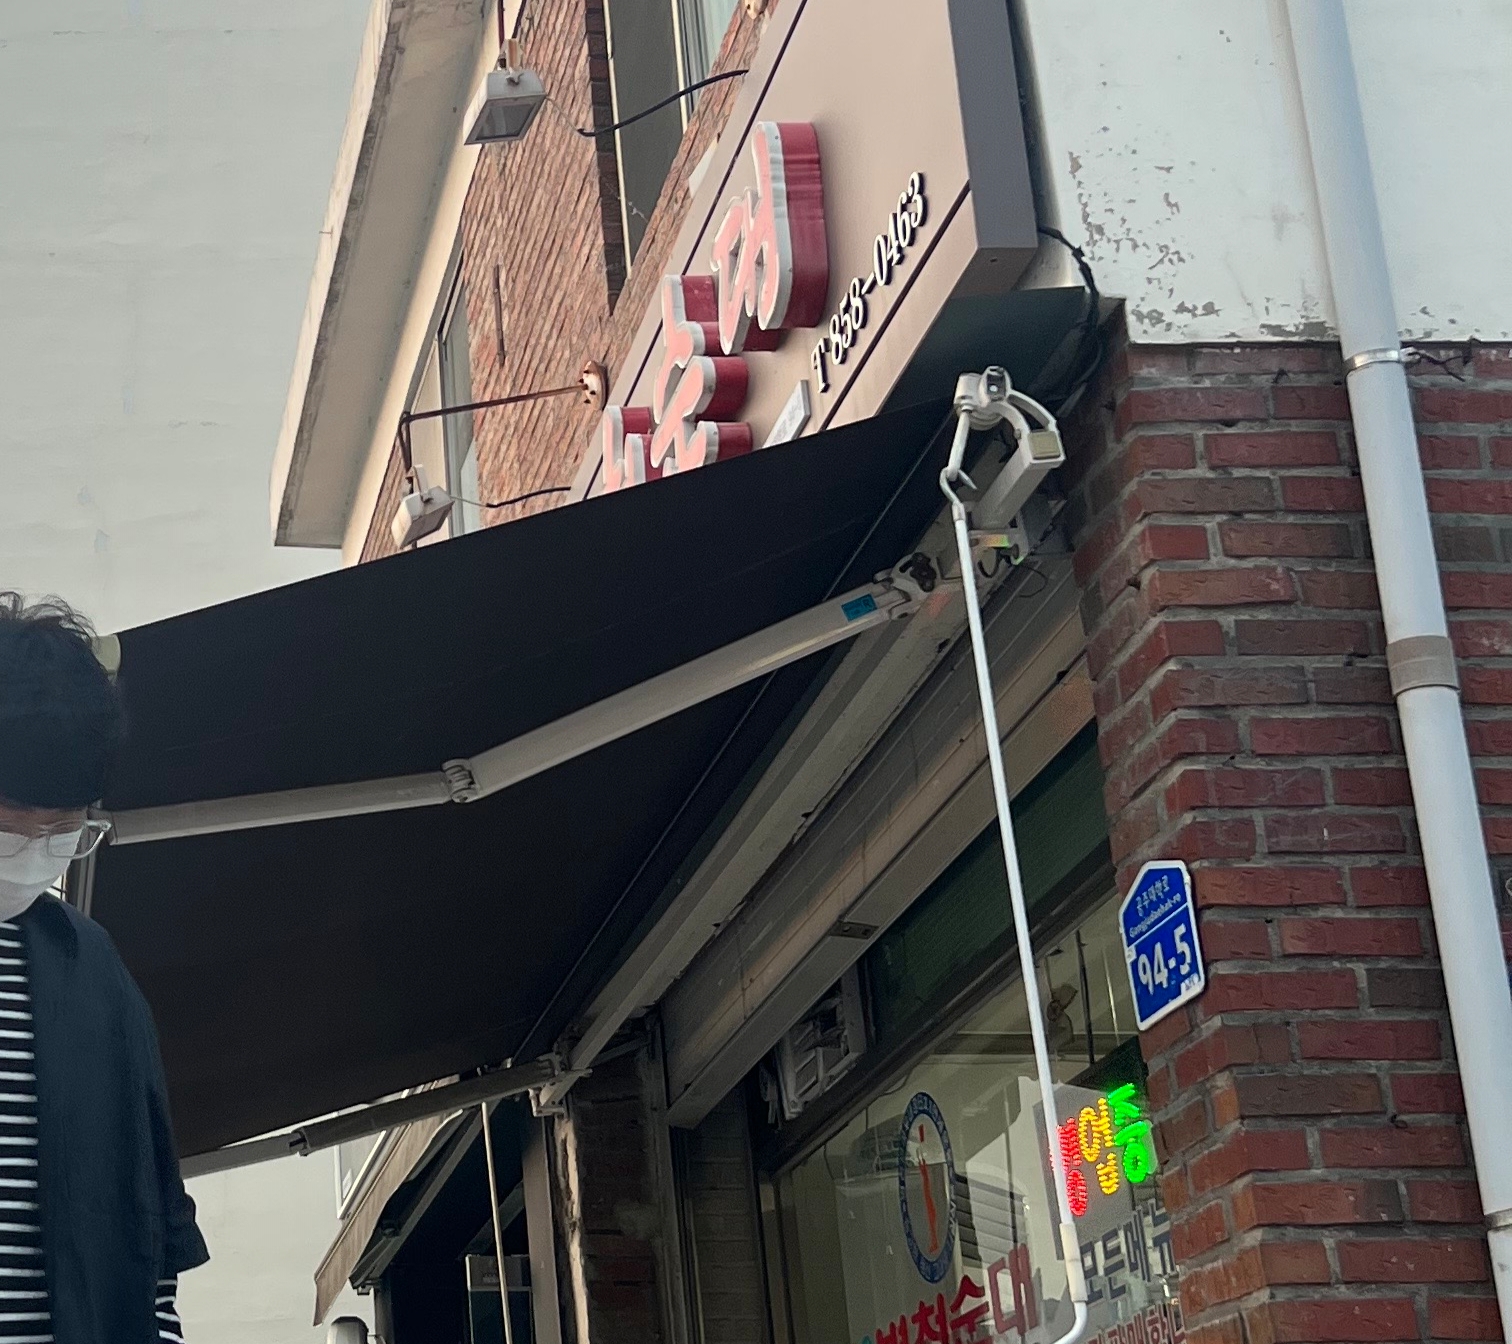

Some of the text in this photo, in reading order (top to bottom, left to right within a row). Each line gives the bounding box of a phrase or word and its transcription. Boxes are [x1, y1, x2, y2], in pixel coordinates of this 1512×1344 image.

[829, 171, 928, 366] 858-0463
[1138, 923, 1192, 995] 94-5
[1079, 1198, 1177, 1304] 모든메뉴
